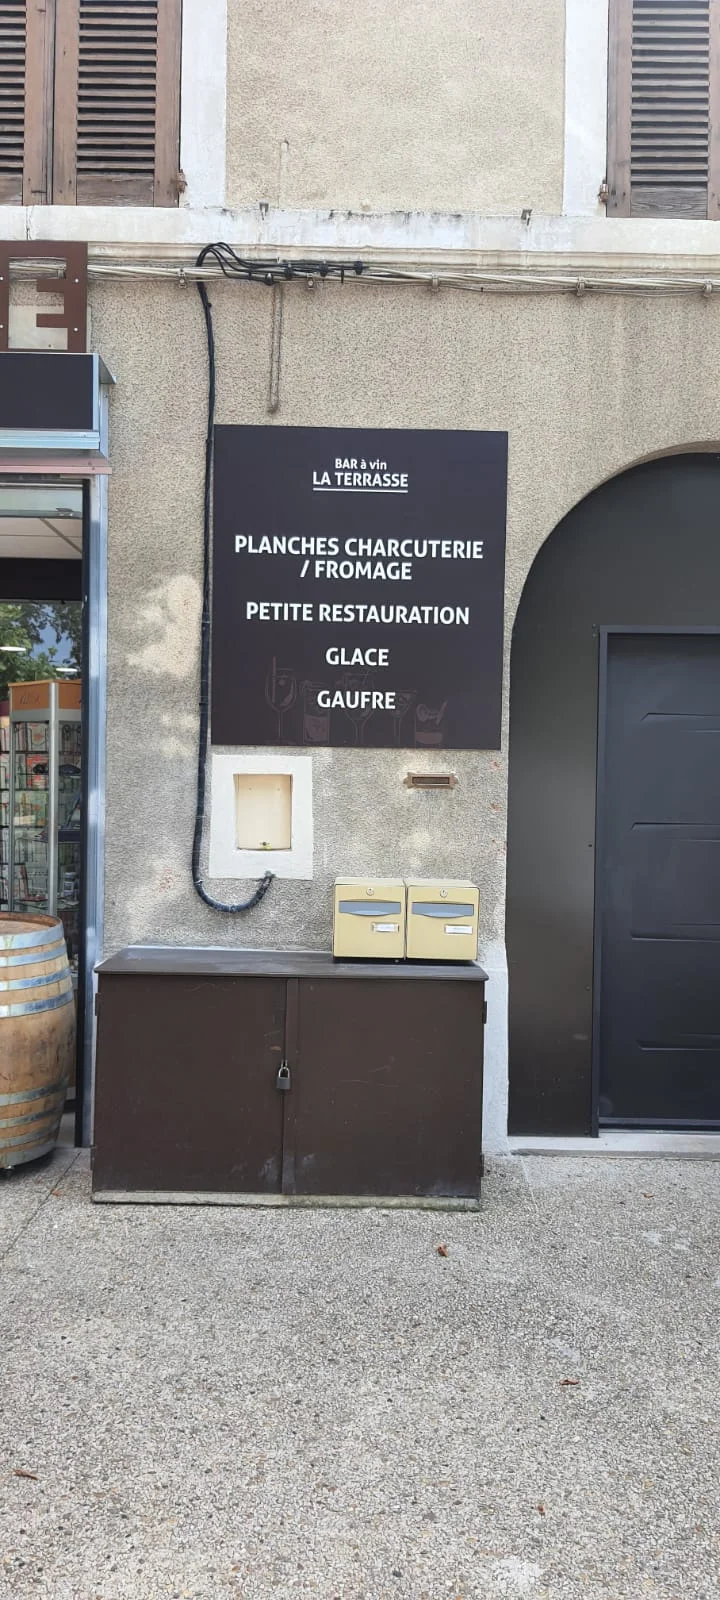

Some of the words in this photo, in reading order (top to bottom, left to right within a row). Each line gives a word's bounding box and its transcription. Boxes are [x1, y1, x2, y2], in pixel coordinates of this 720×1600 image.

[335, 458, 358, 470] BAR
[360, 459, 367, 470] à
[369, 459, 387, 471] vin
[313, 471, 331, 486] LA
[335, 473, 409, 488] TERRASSE
[234, 535, 340, 556] PLANCHES
[344, 538, 484, 559] CHARCUTERIE
[314, 560, 413, 581] FROMAGE
[246, 602, 314, 622] PETITE
[318, 604, 470, 625] RESTAURATION
[325, 647, 390, 667] GLACE
[316, 690, 396, 710] GAUFRE
